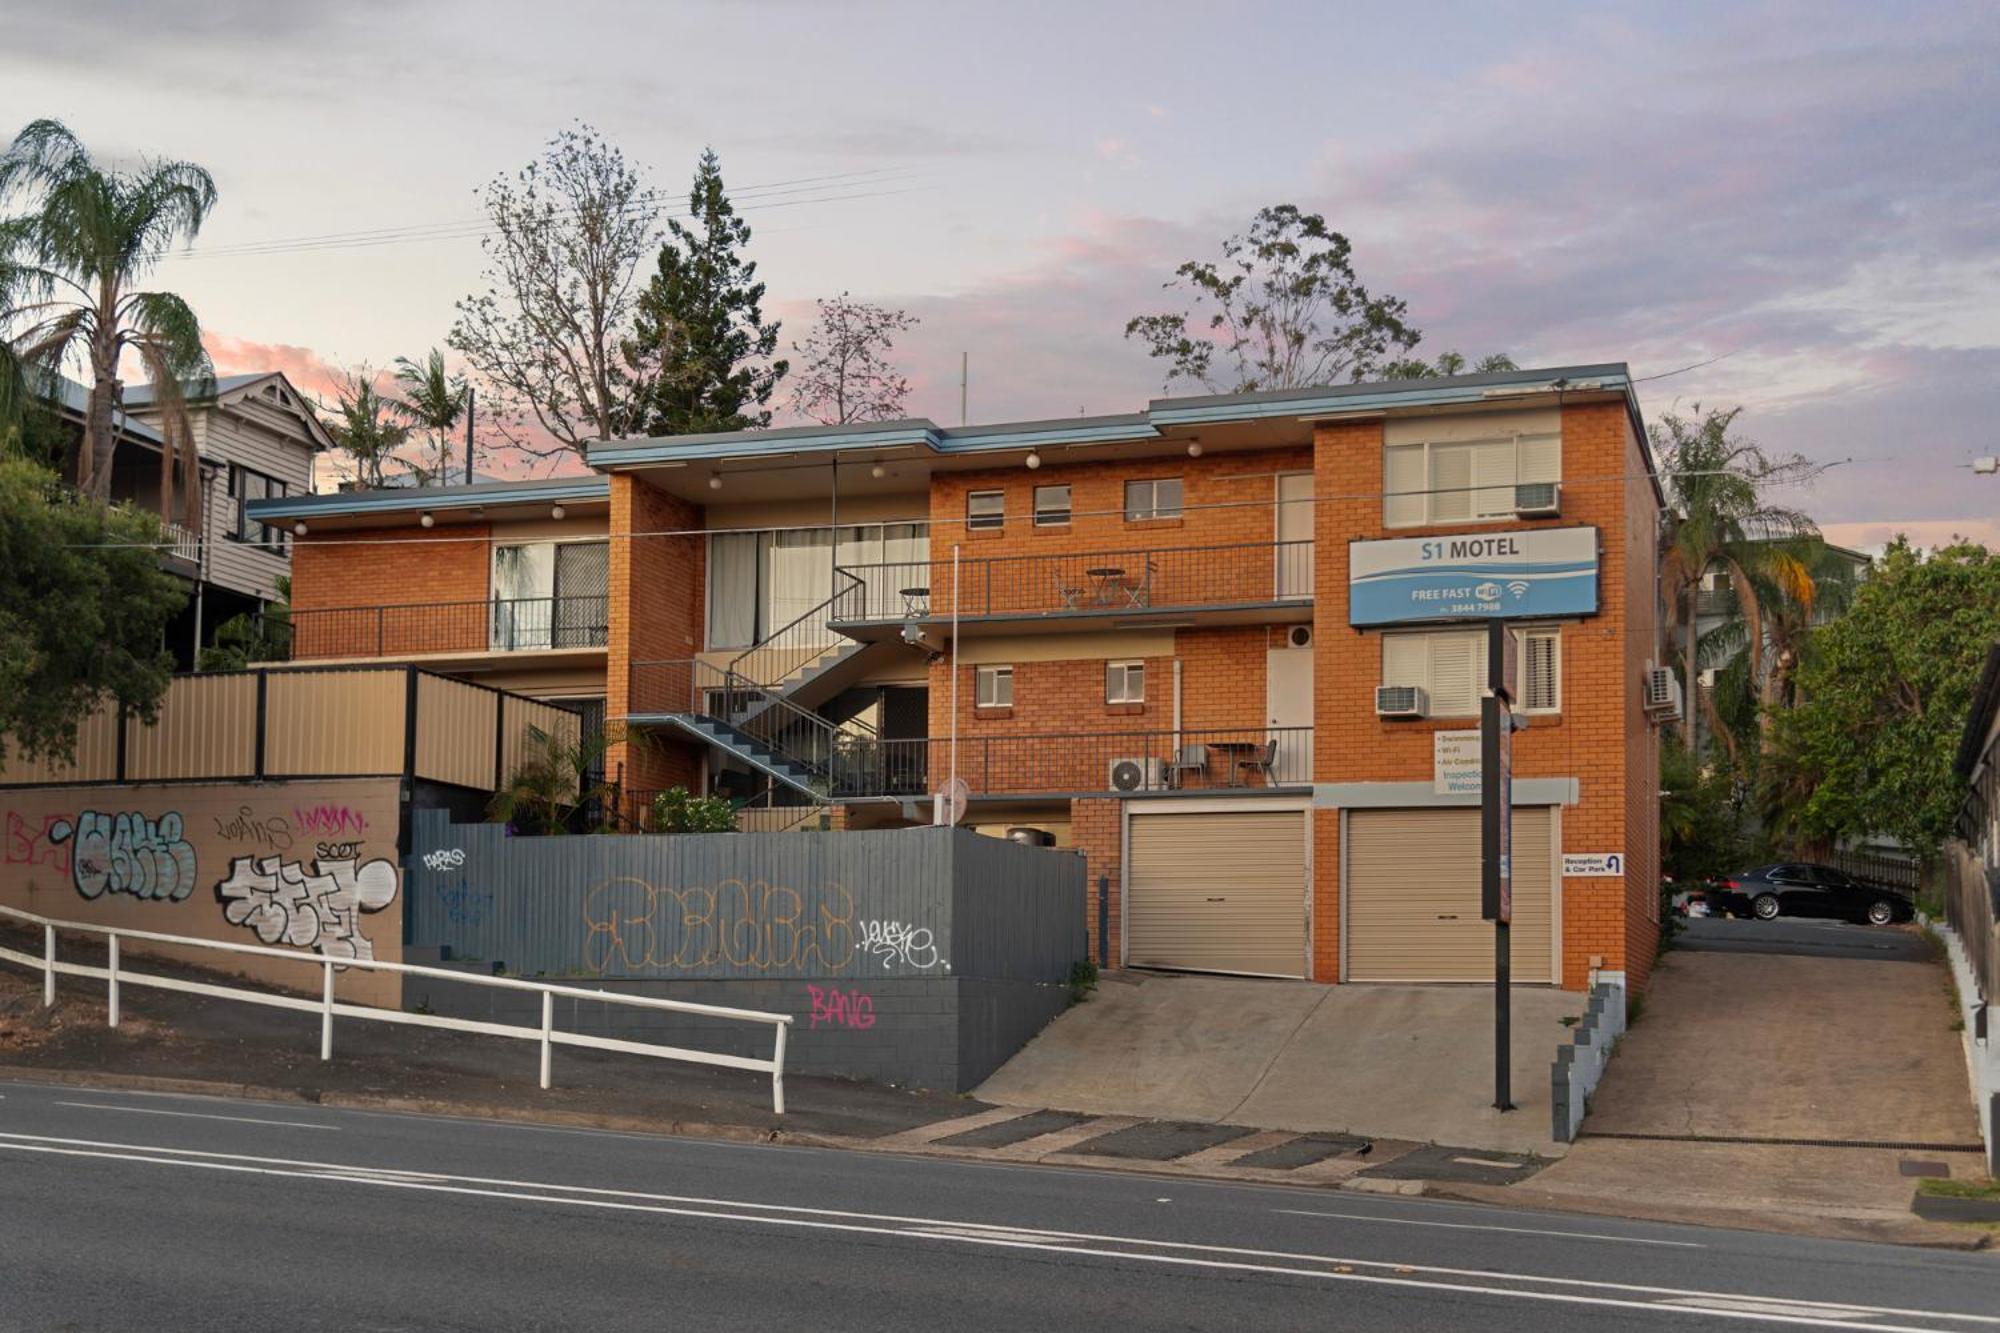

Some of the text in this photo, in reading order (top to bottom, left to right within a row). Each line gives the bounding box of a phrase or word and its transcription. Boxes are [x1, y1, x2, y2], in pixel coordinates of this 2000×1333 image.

[1422, 538, 1520, 560] S1 MOTEL
[1411, 589, 1440, 601] FREE
[1442, 587, 1471, 599] FAST
[1564, 857, 1602, 865] Reception
[806, 982, 877, 1032] BANG
